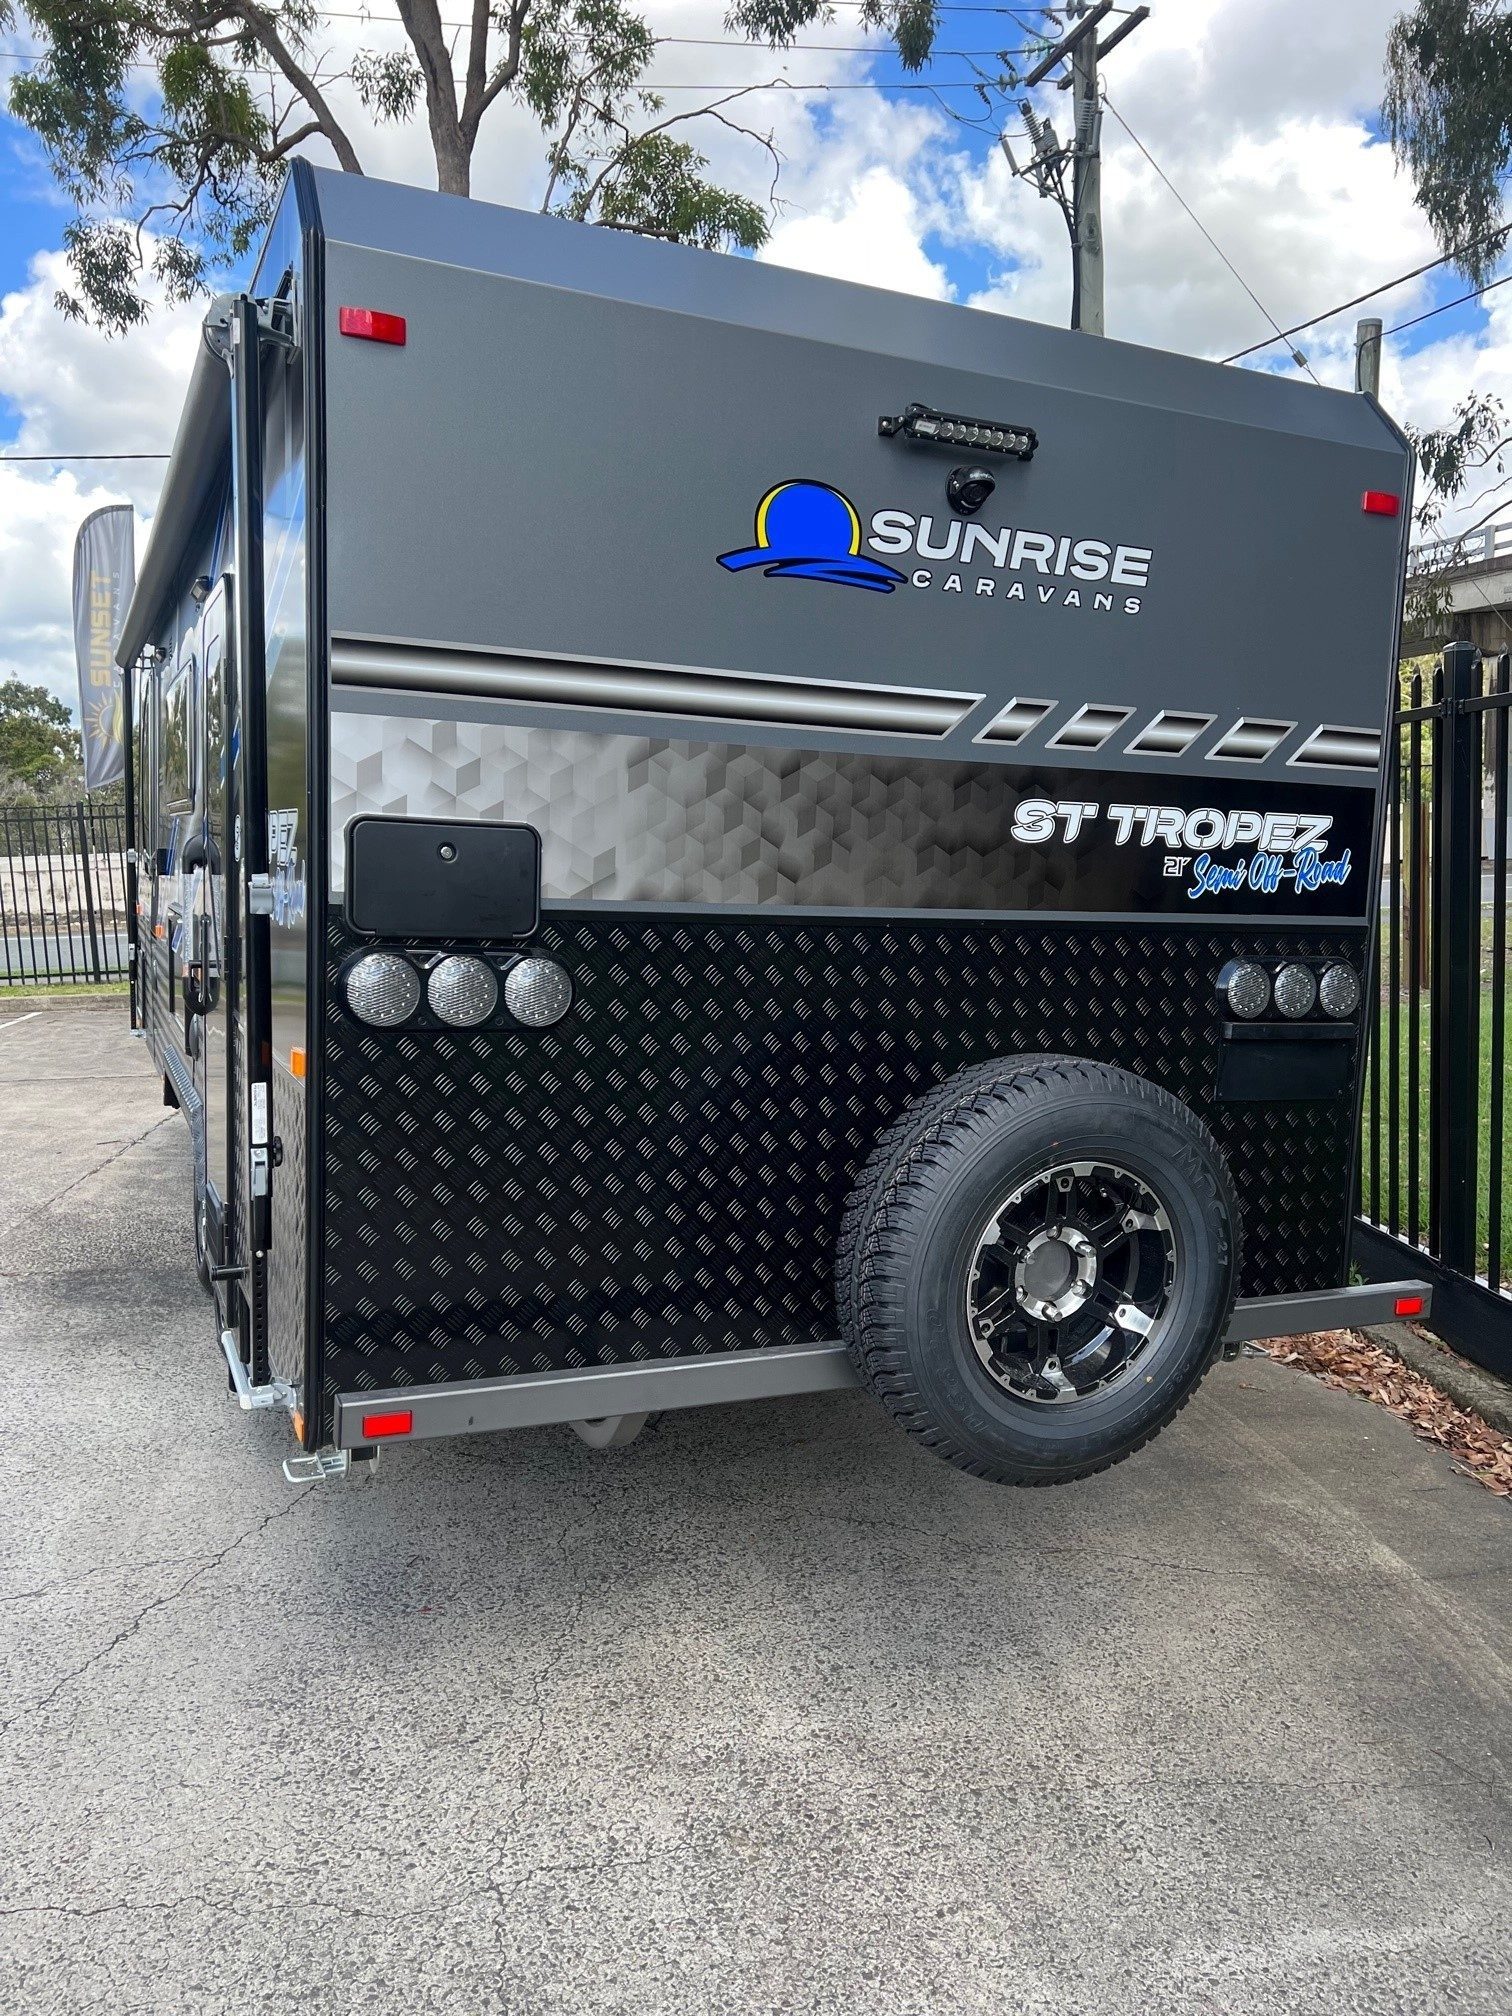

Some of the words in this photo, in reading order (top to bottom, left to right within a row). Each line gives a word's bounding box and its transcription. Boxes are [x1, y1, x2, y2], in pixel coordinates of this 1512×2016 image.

[868, 509, 1153, 588] SUNRISE
[911, 569, 1142, 615] CARAVANS
[90, 571, 111, 687] SUNSET
[1010, 799, 1099, 844] ST
[1107, 804, 1334, 853] TROPEZ
[1187, 852, 1247, 899] Semi
[1248, 846, 1352, 895] Off-Road
